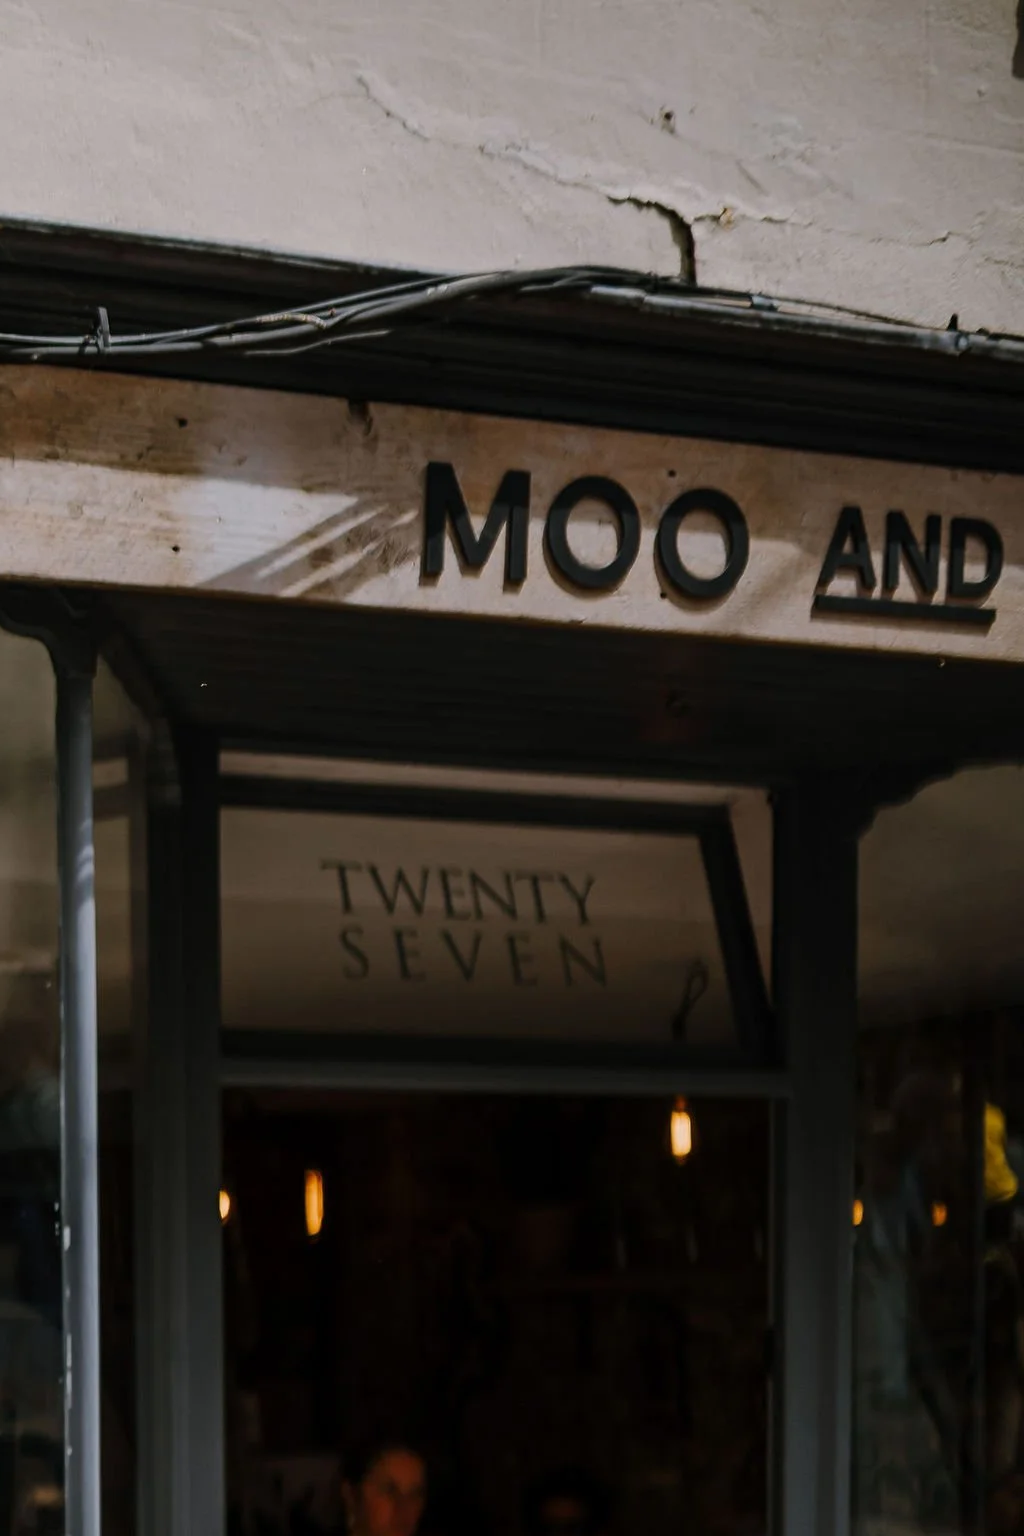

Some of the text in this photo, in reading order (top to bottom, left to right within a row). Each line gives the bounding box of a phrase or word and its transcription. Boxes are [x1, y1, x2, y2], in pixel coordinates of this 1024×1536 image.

[421, 461, 1005, 602] MOO AND
[319, 857, 597, 926] TWENTY
[338, 923, 609, 988] SEVEN
